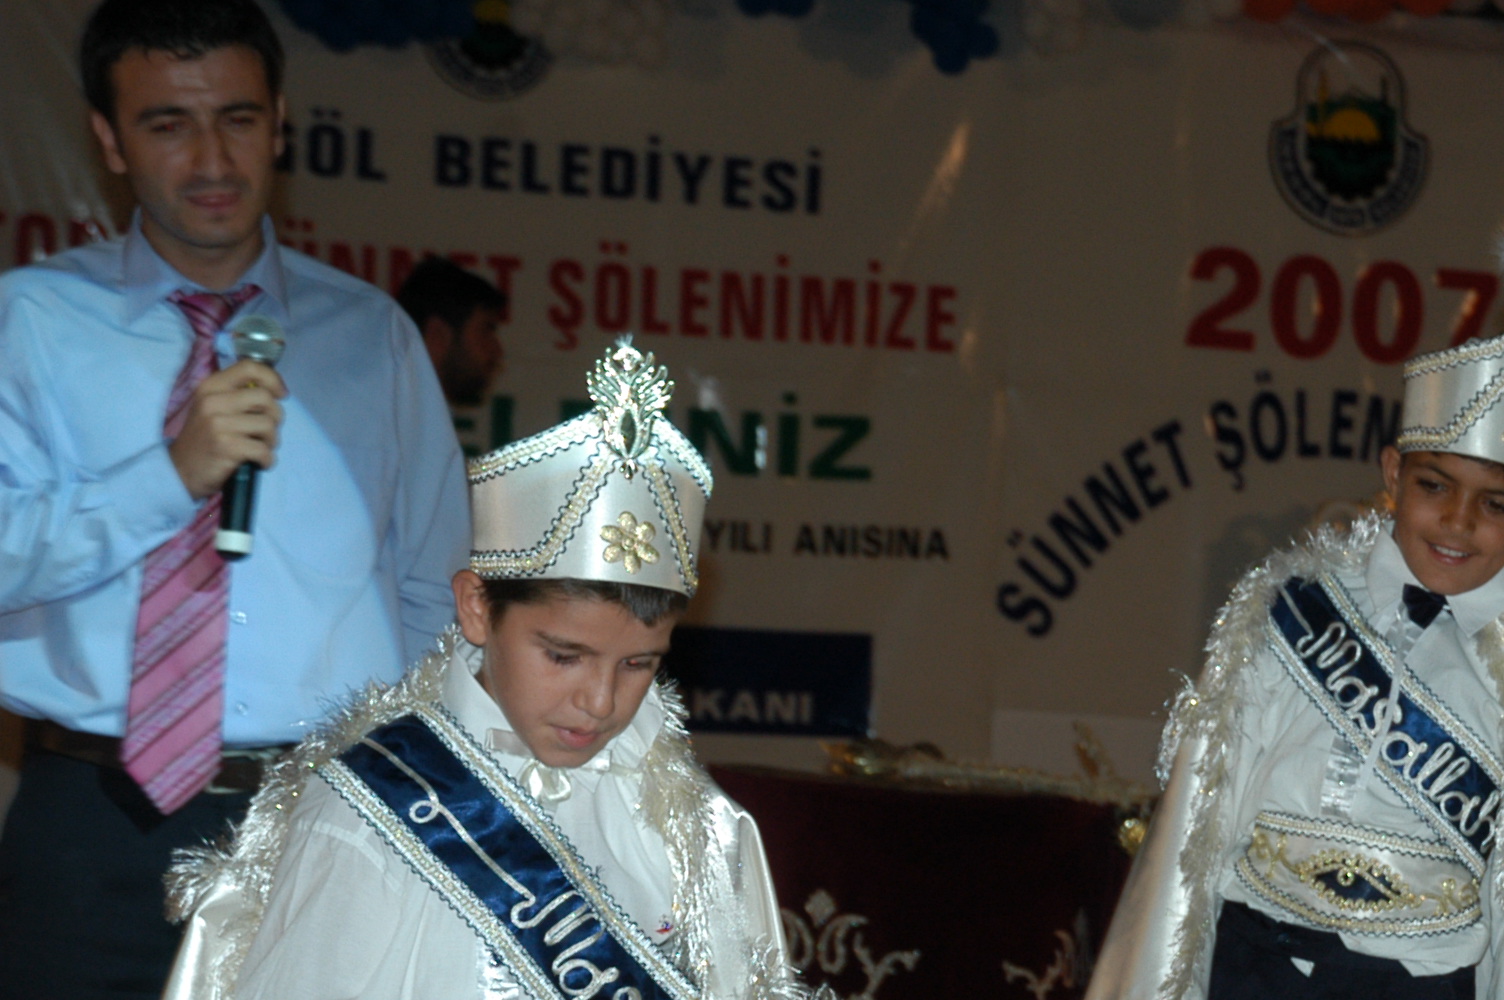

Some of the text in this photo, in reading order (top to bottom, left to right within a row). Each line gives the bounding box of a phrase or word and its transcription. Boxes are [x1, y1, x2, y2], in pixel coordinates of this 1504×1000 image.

[435, 134, 823, 215] BELEDİYESİ
[548, 240, 960, 352] ŞÖLENİMİZE
[1184, 246, 1499, 365] 2007
[703, 519, 952, 562] YILI ANISINA
[995, 418, 1194, 638] SÜNNET
